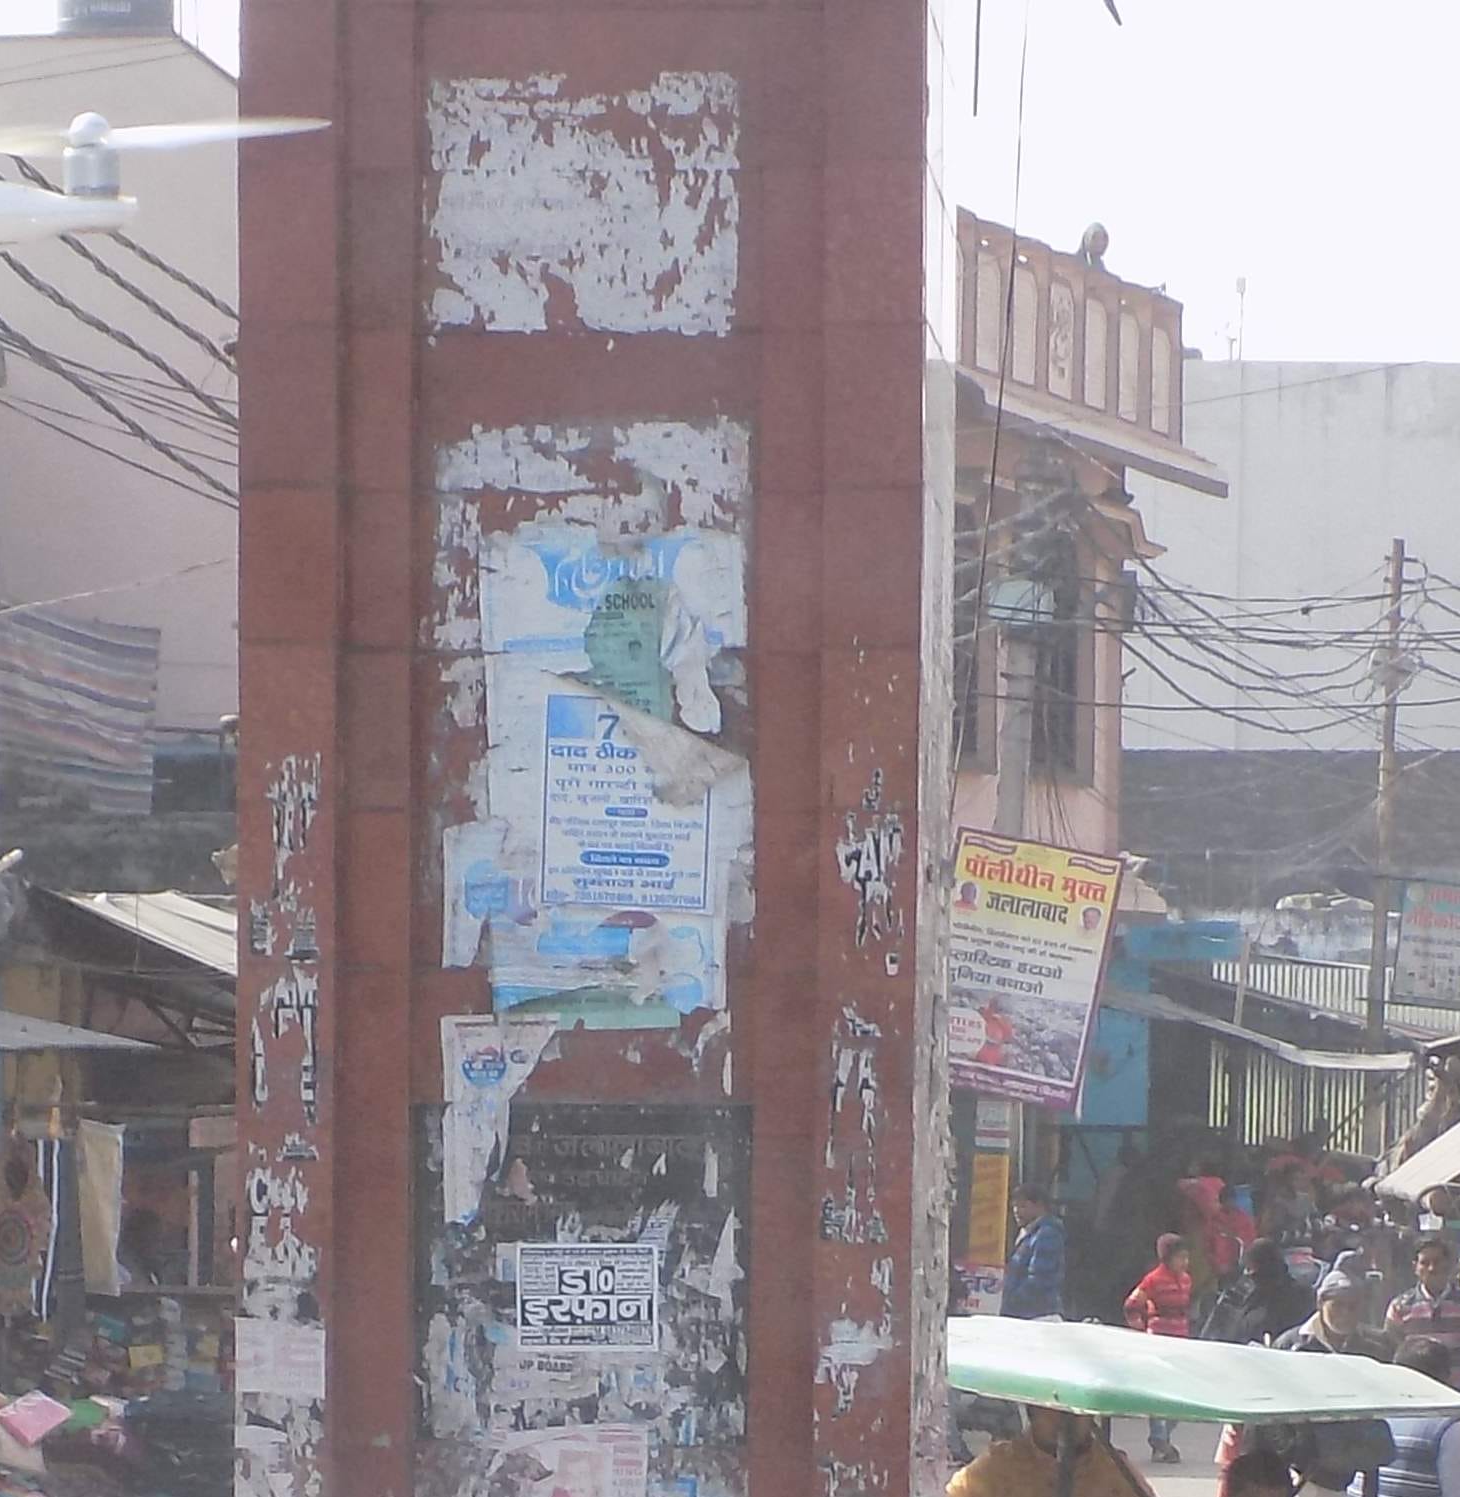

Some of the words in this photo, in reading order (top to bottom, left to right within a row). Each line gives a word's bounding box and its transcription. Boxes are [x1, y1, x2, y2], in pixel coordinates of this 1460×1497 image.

[604, 593, 656, 611] SCHOOL
[966, 854, 1055, 892] पॉलीथीन
[1062, 876, 1108, 903] मुक्त
[986, 891, 1069, 925] जलालाबाद
